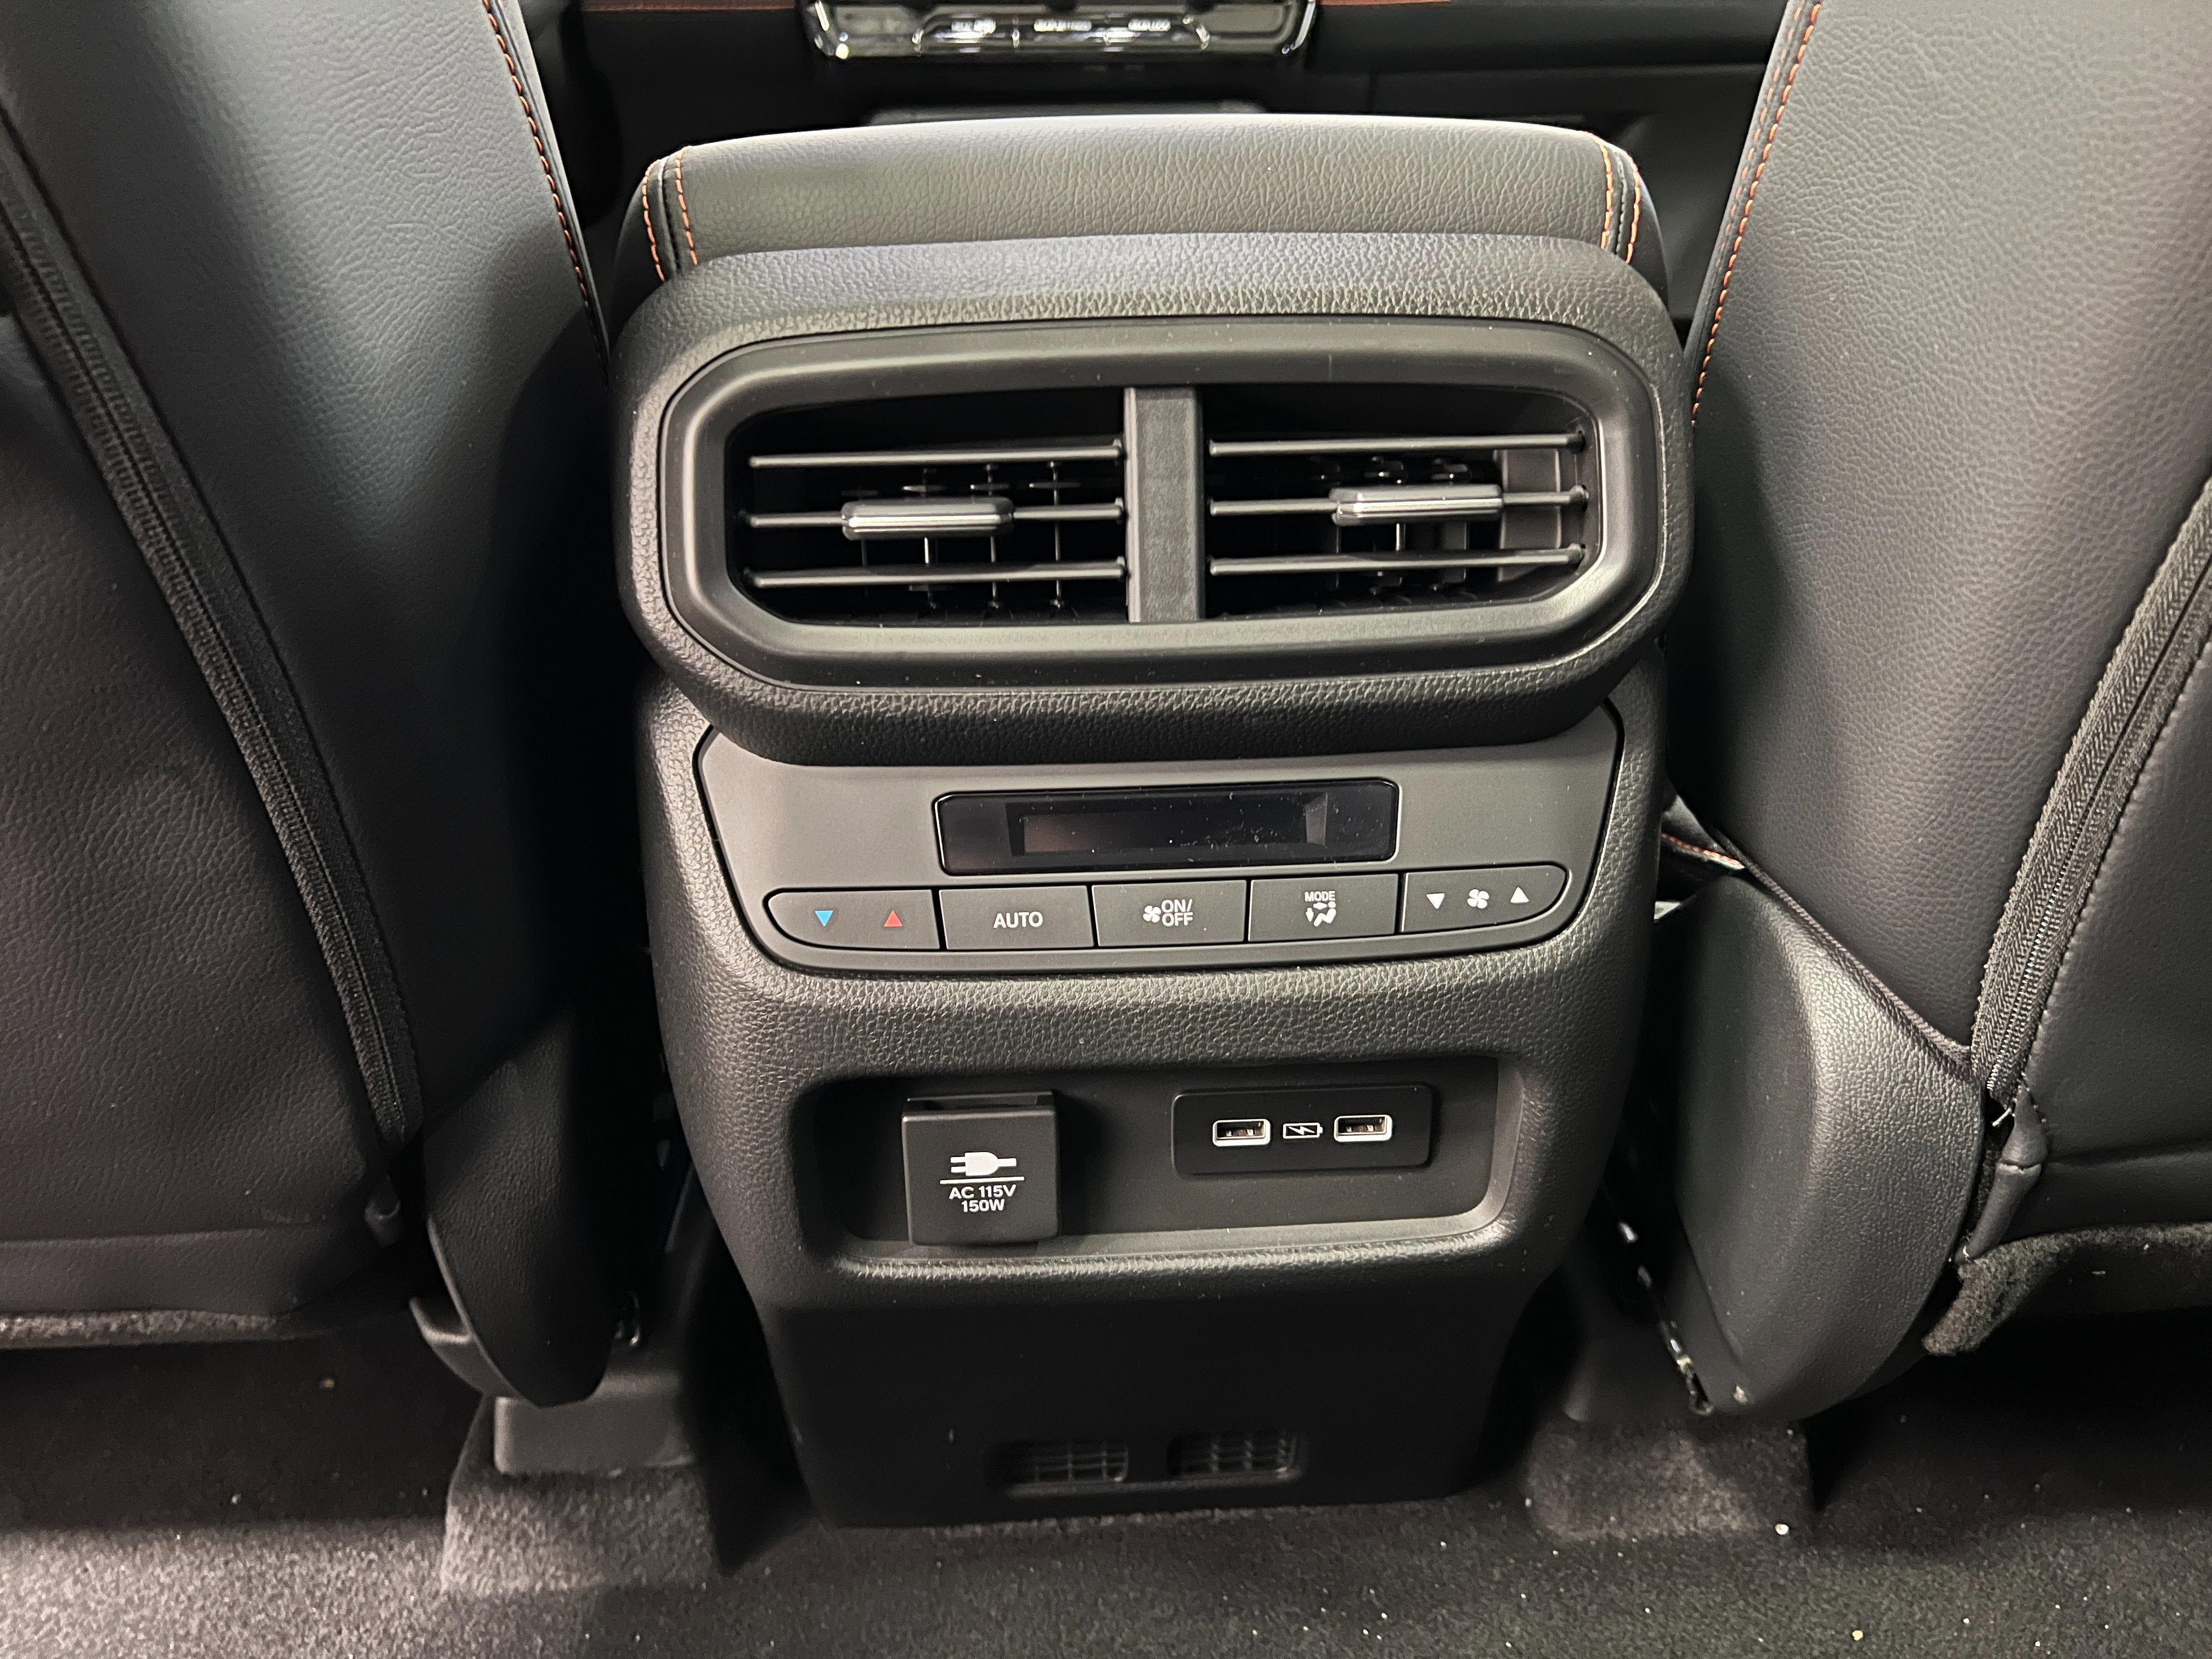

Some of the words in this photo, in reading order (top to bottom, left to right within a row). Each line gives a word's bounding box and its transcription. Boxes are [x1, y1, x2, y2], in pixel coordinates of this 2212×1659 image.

[1304, 890, 1336, 902] MODE
[1161, 899, 1193, 912] ON/
[993, 911, 1043, 929] AUTO
[1161, 912, 1194, 927] OFF
[949, 1186, 974, 1200] AC
[978, 1184, 1017, 1198] 115V
[961, 1199, 1005, 1212] 150W
